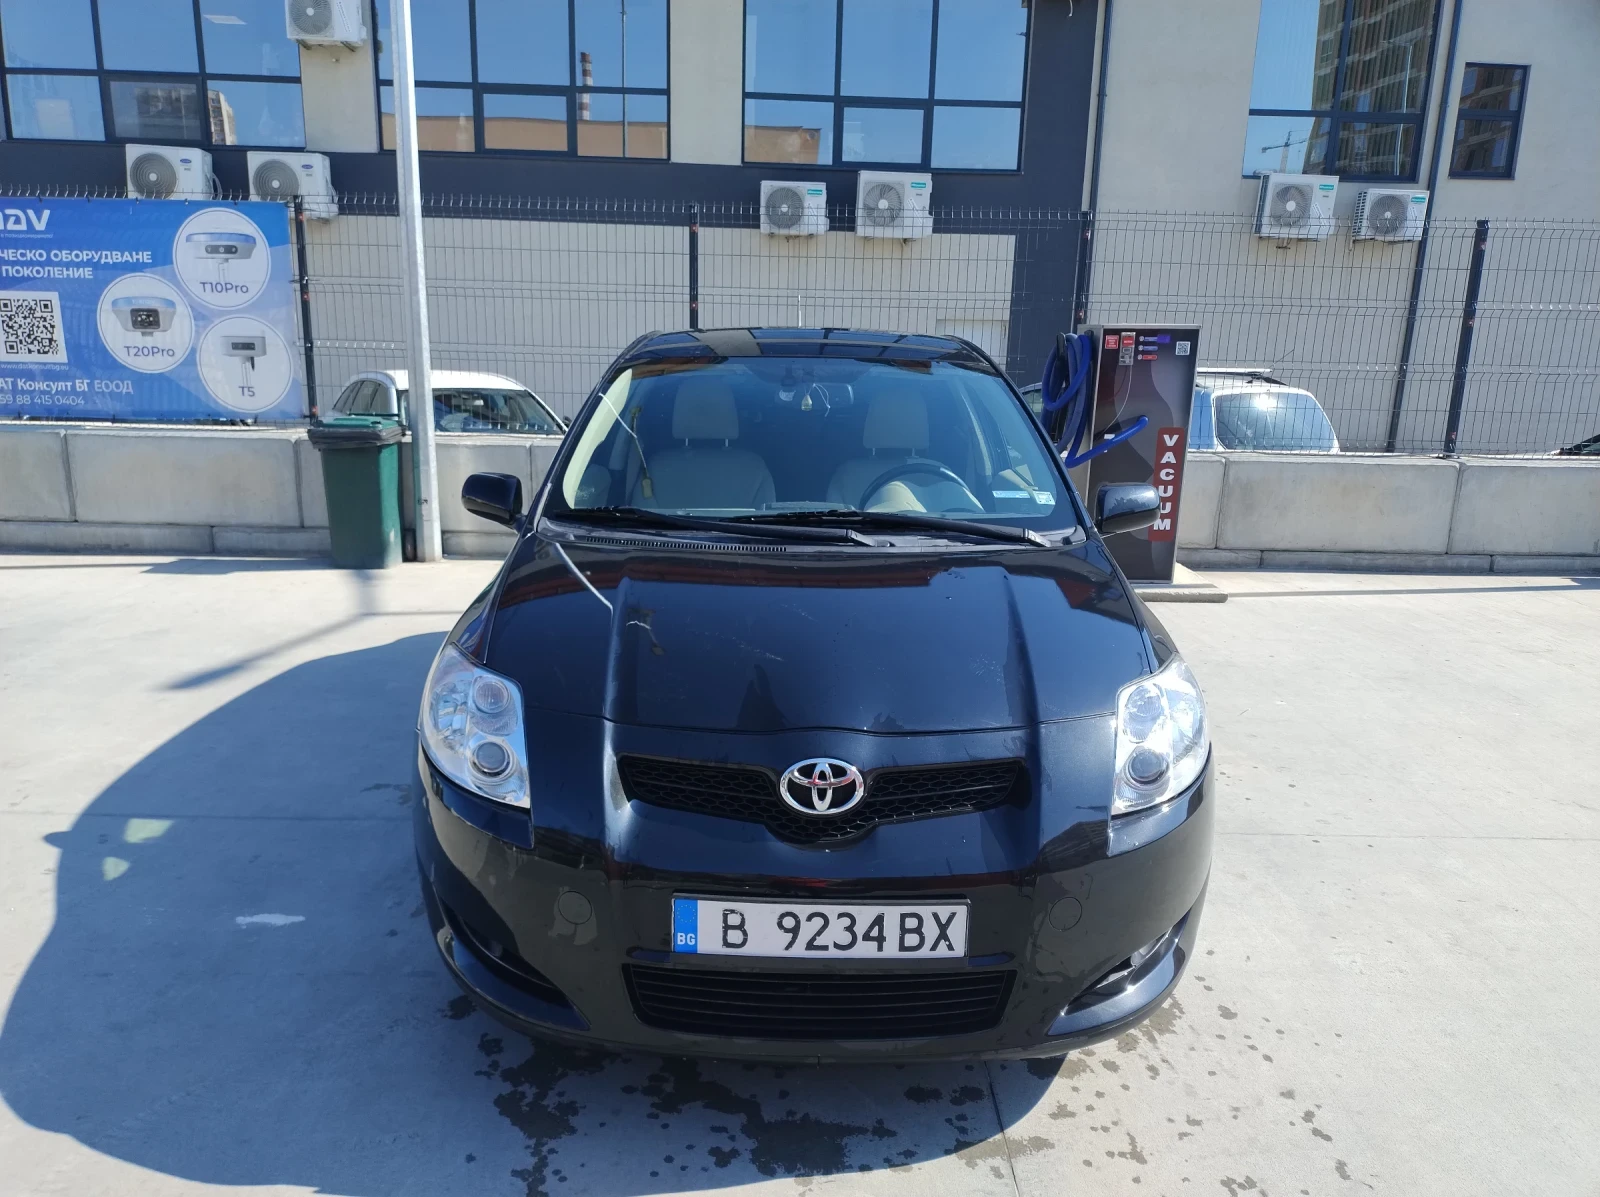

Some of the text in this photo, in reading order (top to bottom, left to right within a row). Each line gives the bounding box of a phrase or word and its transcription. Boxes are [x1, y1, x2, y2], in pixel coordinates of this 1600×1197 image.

[50, 250, 153, 264] ОБОРУДВАНЕ
[1, 266, 94, 279] ПОКОЛЕНИЕ
[200, 281, 249, 294] T10Pro
[124, 346, 176, 357] T20Pro
[17, 378, 73, 394] Консулт
[75, 380, 91, 391] БГ
[94, 380, 134, 394] ЕООД
[238, 386, 256, 397] T5
[16, 394, 31, 405] 88
[34, 395, 53, 405] 415
[54, 396, 85, 406] 0404
[1153, 434, 1180, 531] VACUUM
[721, 908, 957, 953] B 9234 BX
[676, 932, 696, 946] BG
